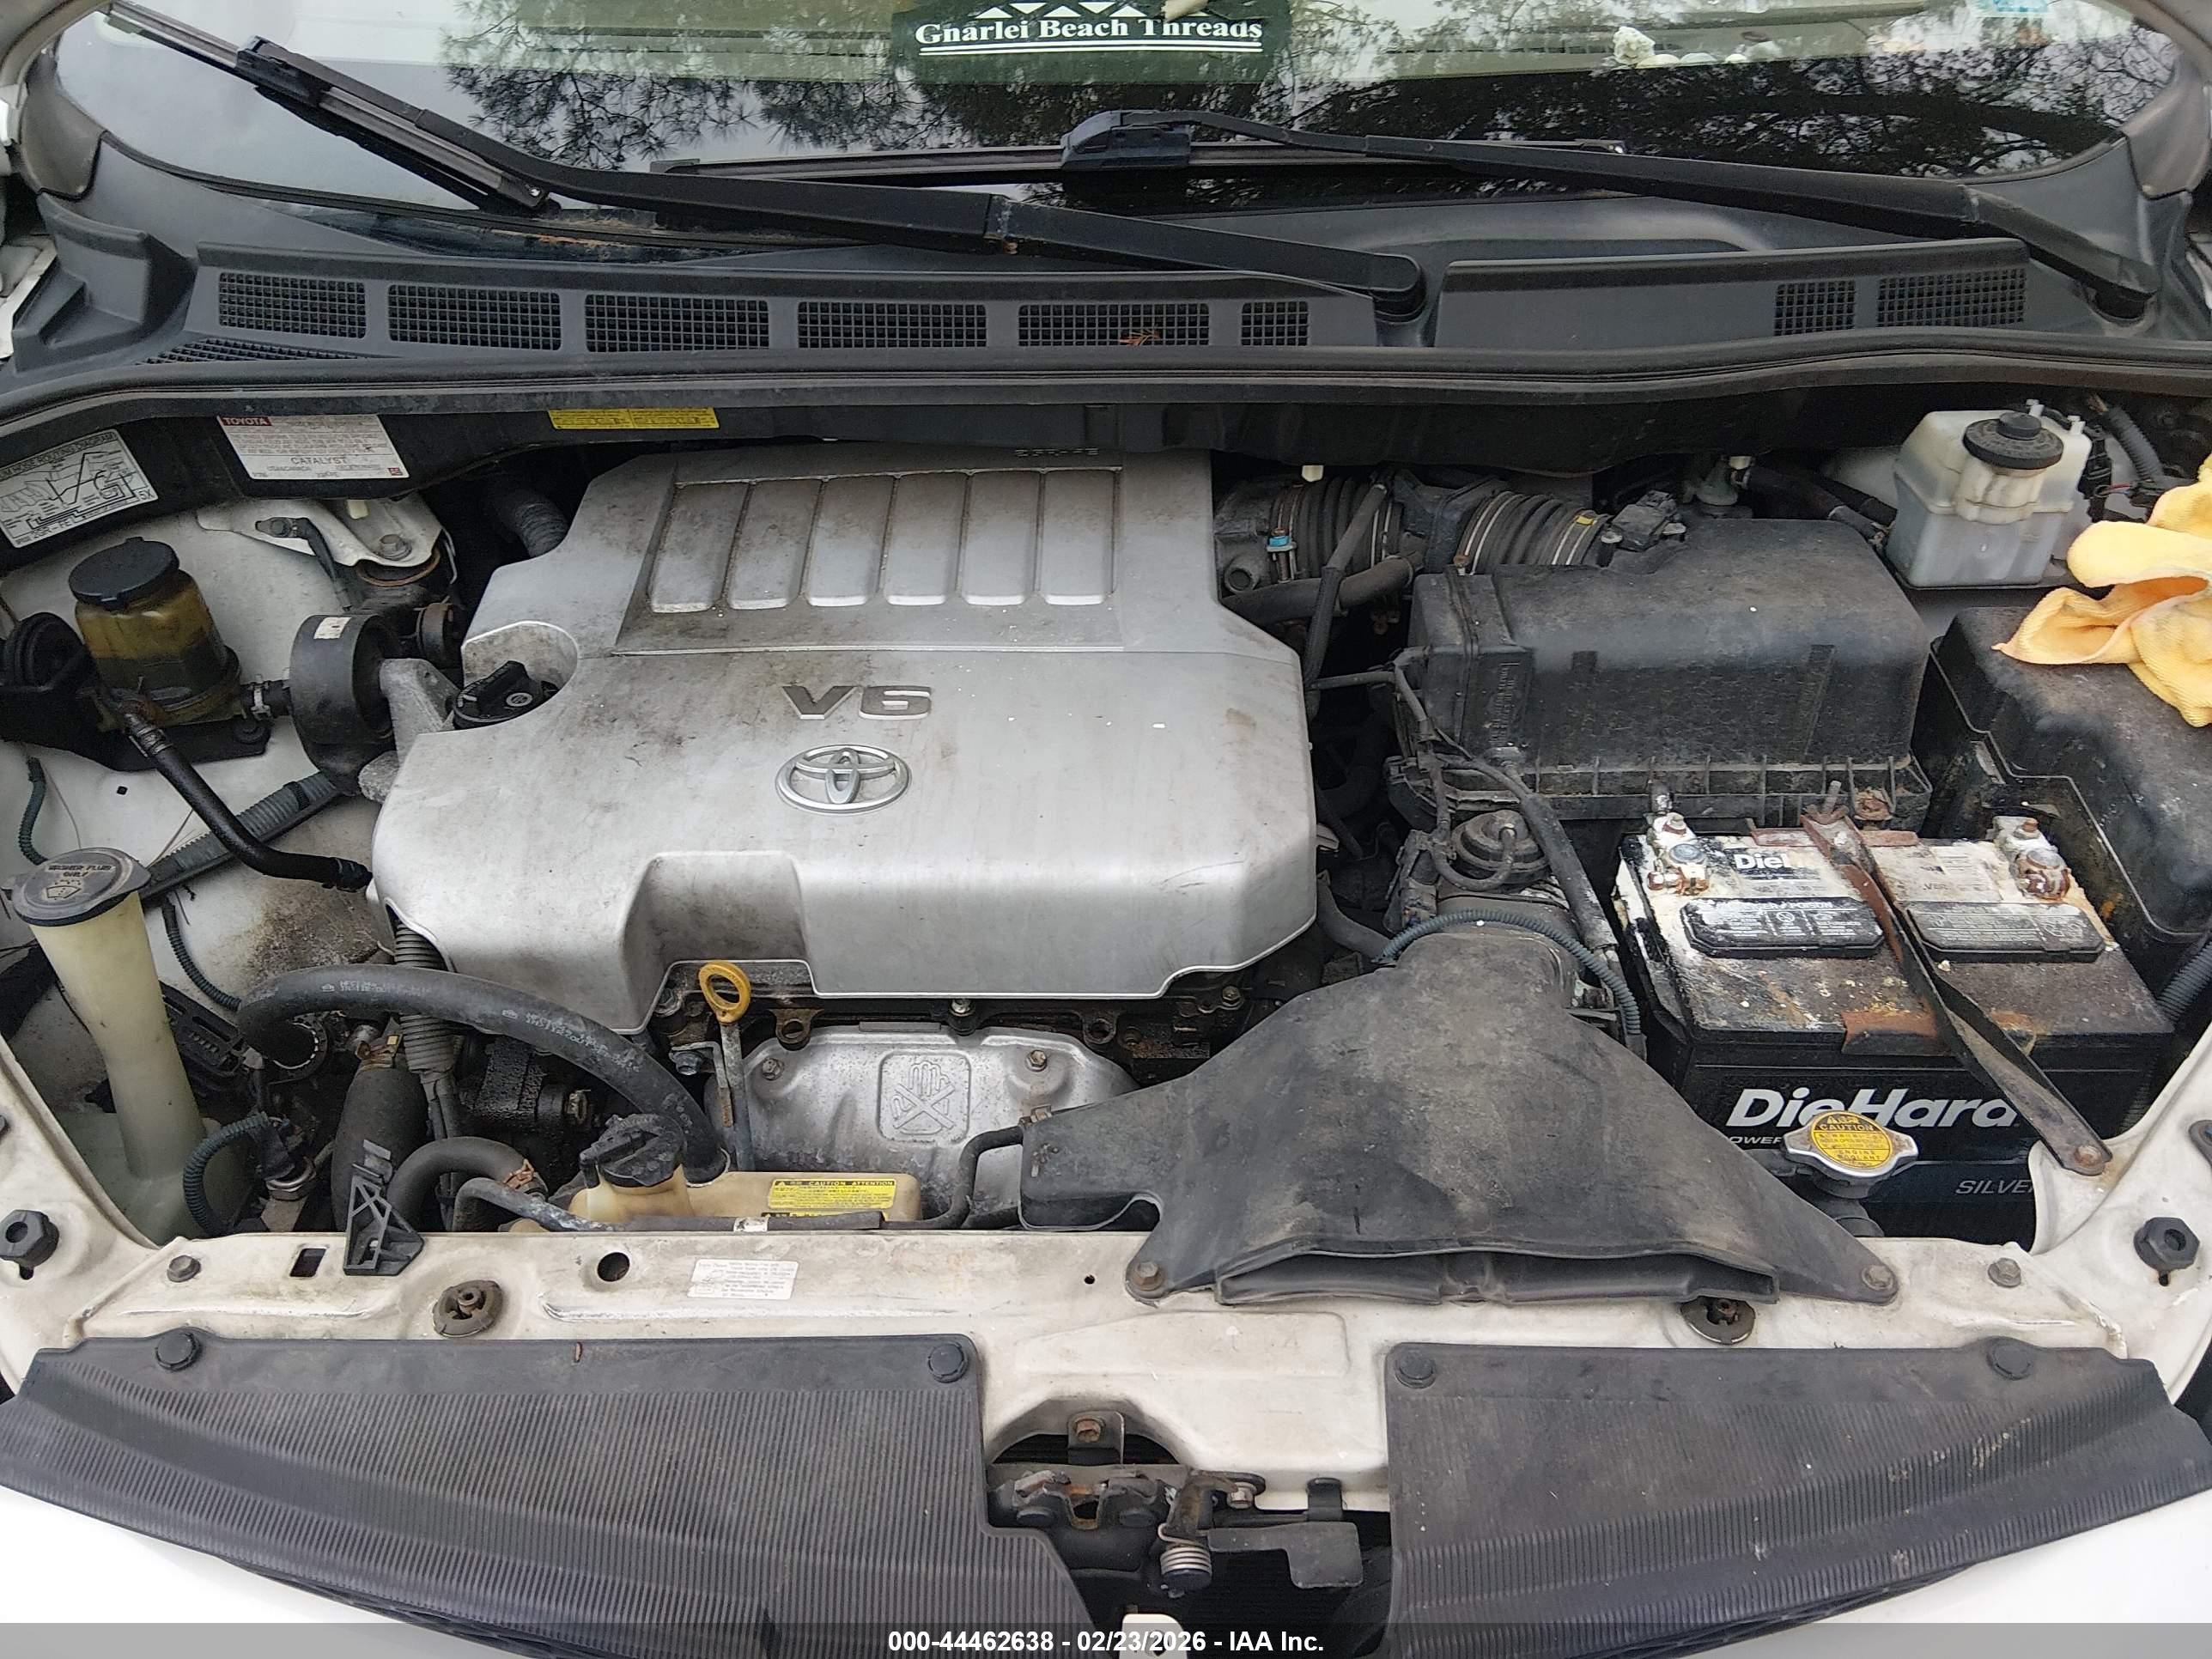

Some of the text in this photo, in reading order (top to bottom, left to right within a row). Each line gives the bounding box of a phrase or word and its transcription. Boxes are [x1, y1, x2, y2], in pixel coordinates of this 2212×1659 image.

[915, 20, 1030, 44] Gnarlei
[1038, 20, 1129, 39] Beach
[223, 417, 268, 426] TOYOTA
[781, 685, 933, 720] V6
[1955, 1179, 2033, 1194] SILVE
